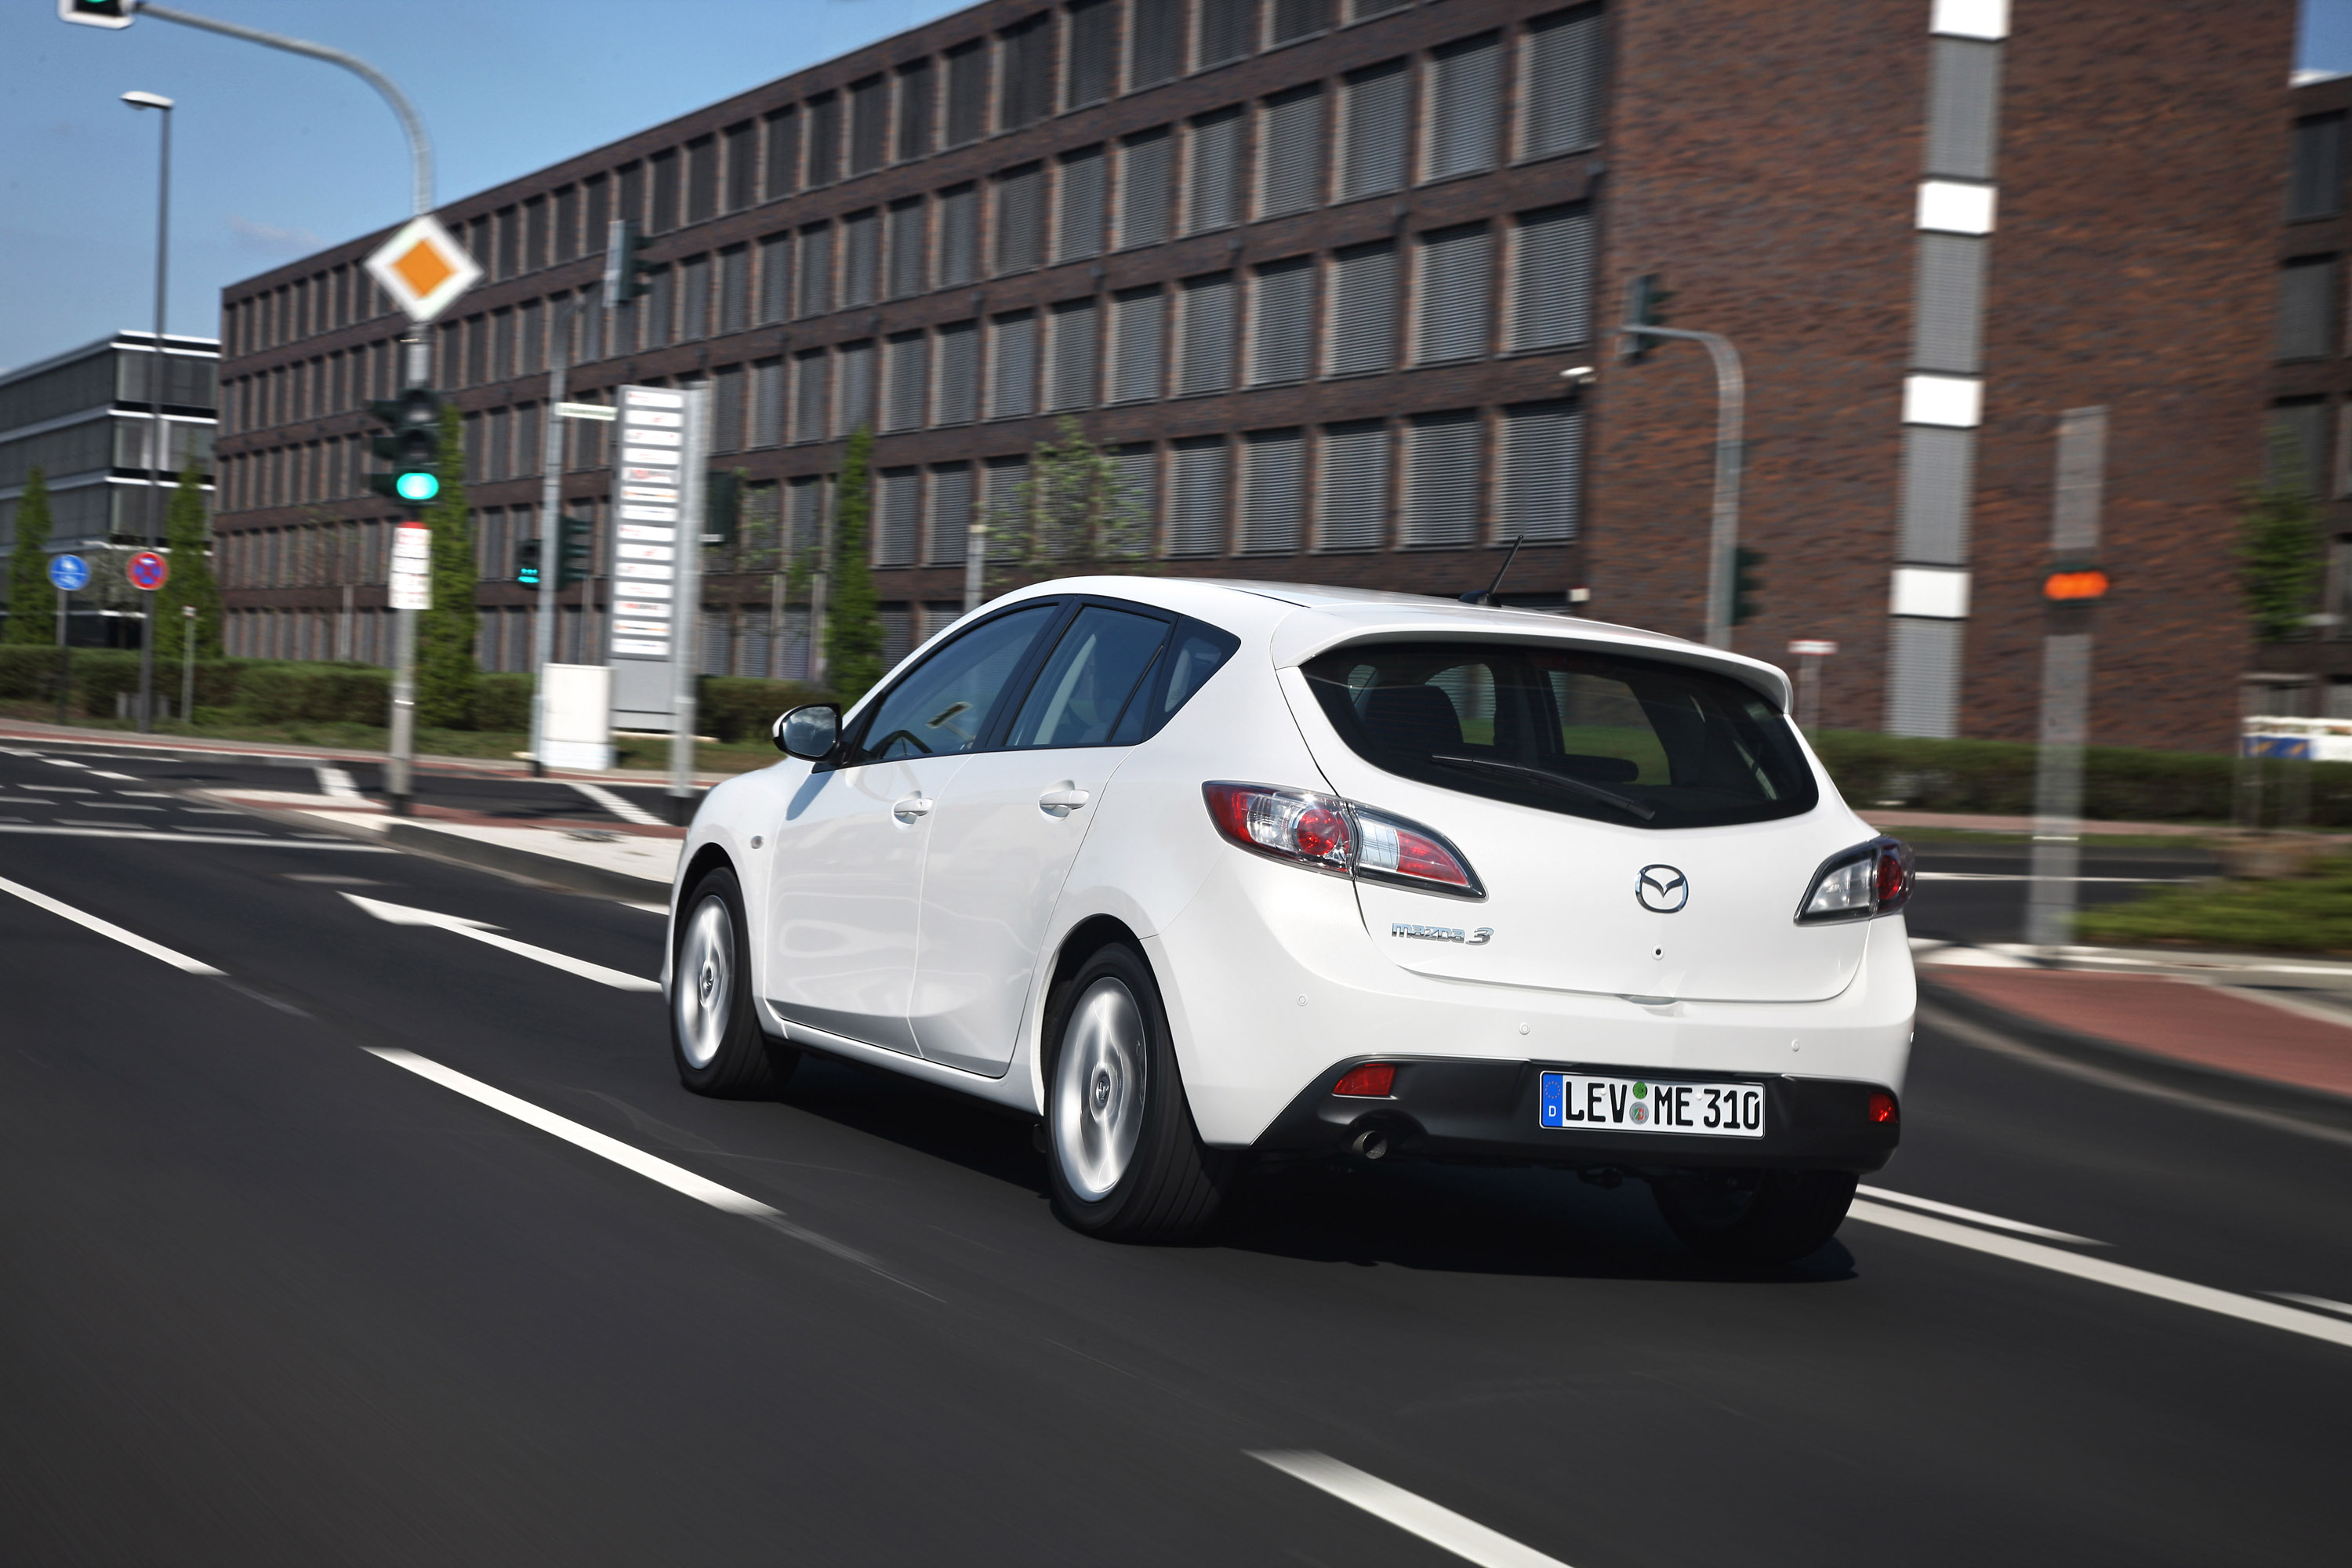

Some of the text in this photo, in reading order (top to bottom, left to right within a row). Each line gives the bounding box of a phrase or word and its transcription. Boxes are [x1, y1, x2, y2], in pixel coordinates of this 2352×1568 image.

[1465, 927, 1494, 946] 3
[1548, 1105, 1557, 1117] D
[1565, 1080, 1760, 1130] LEV ME 310
